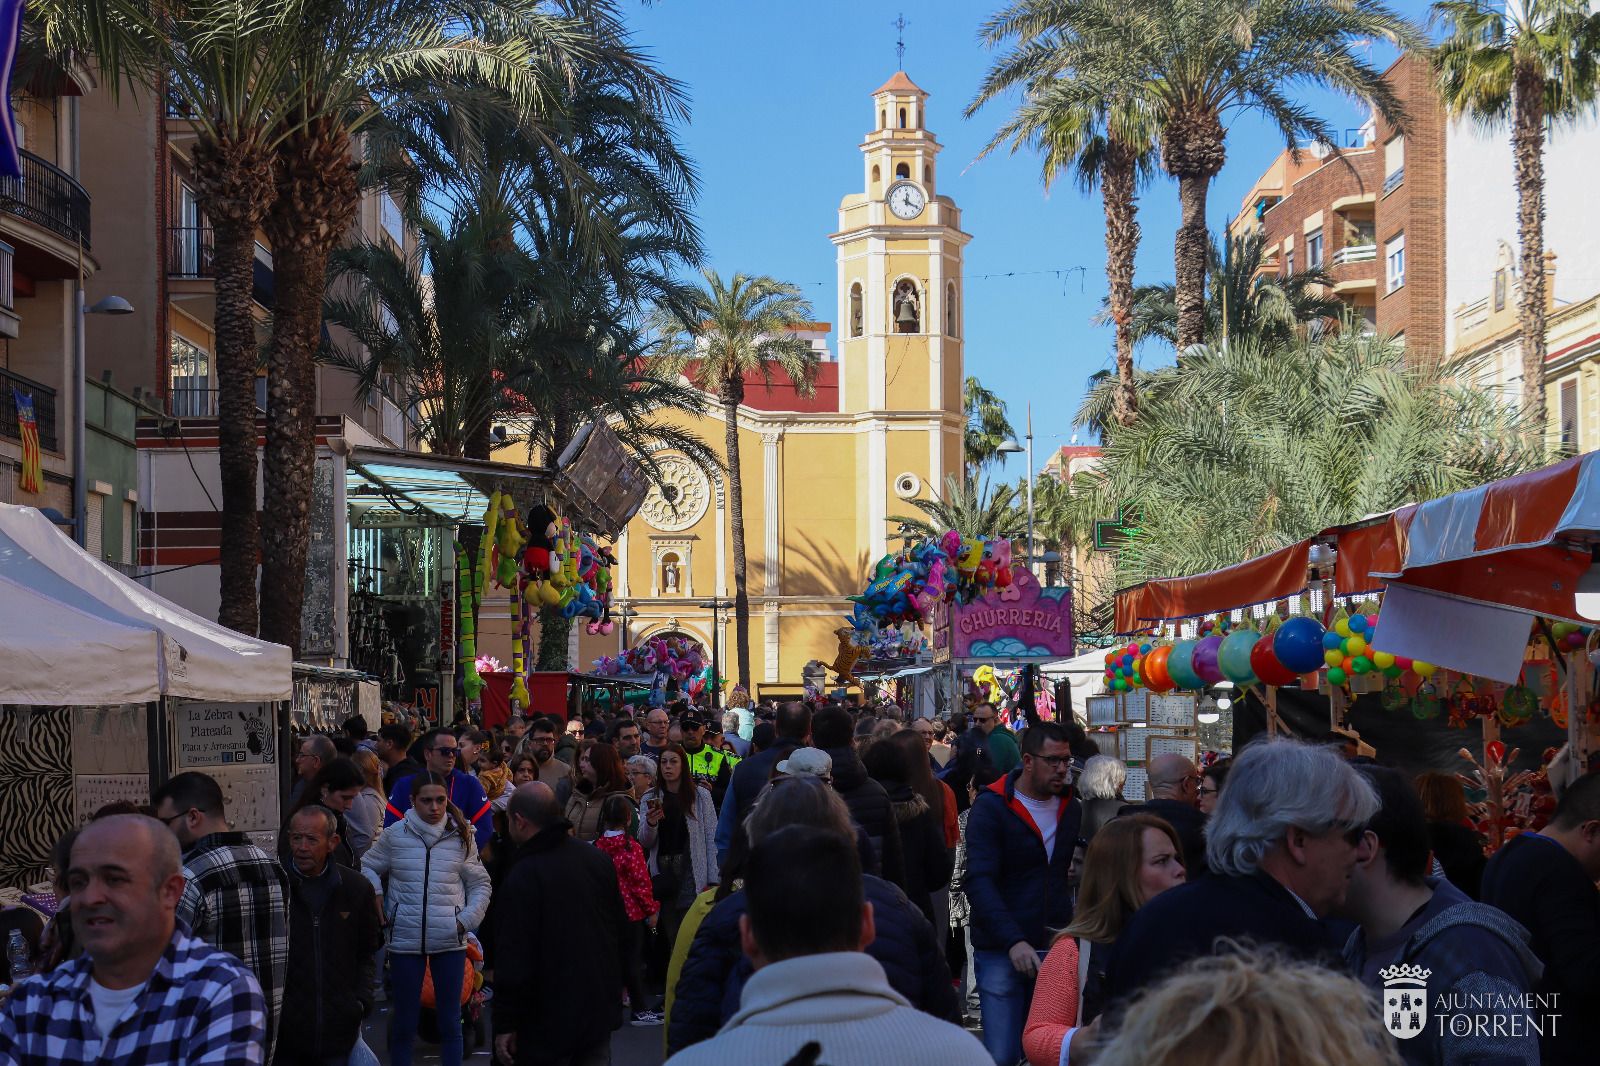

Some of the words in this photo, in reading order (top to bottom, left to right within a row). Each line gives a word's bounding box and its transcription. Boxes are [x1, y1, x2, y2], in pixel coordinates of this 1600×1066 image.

[960, 608, 1062, 634] CHURRERIA
[188, 710, 201, 721] La
[204, 708, 233, 721] Zebra
[190, 724, 233, 737] Plateada
[182, 743, 201, 752] Plata
[203, 743, 209, 752] y
